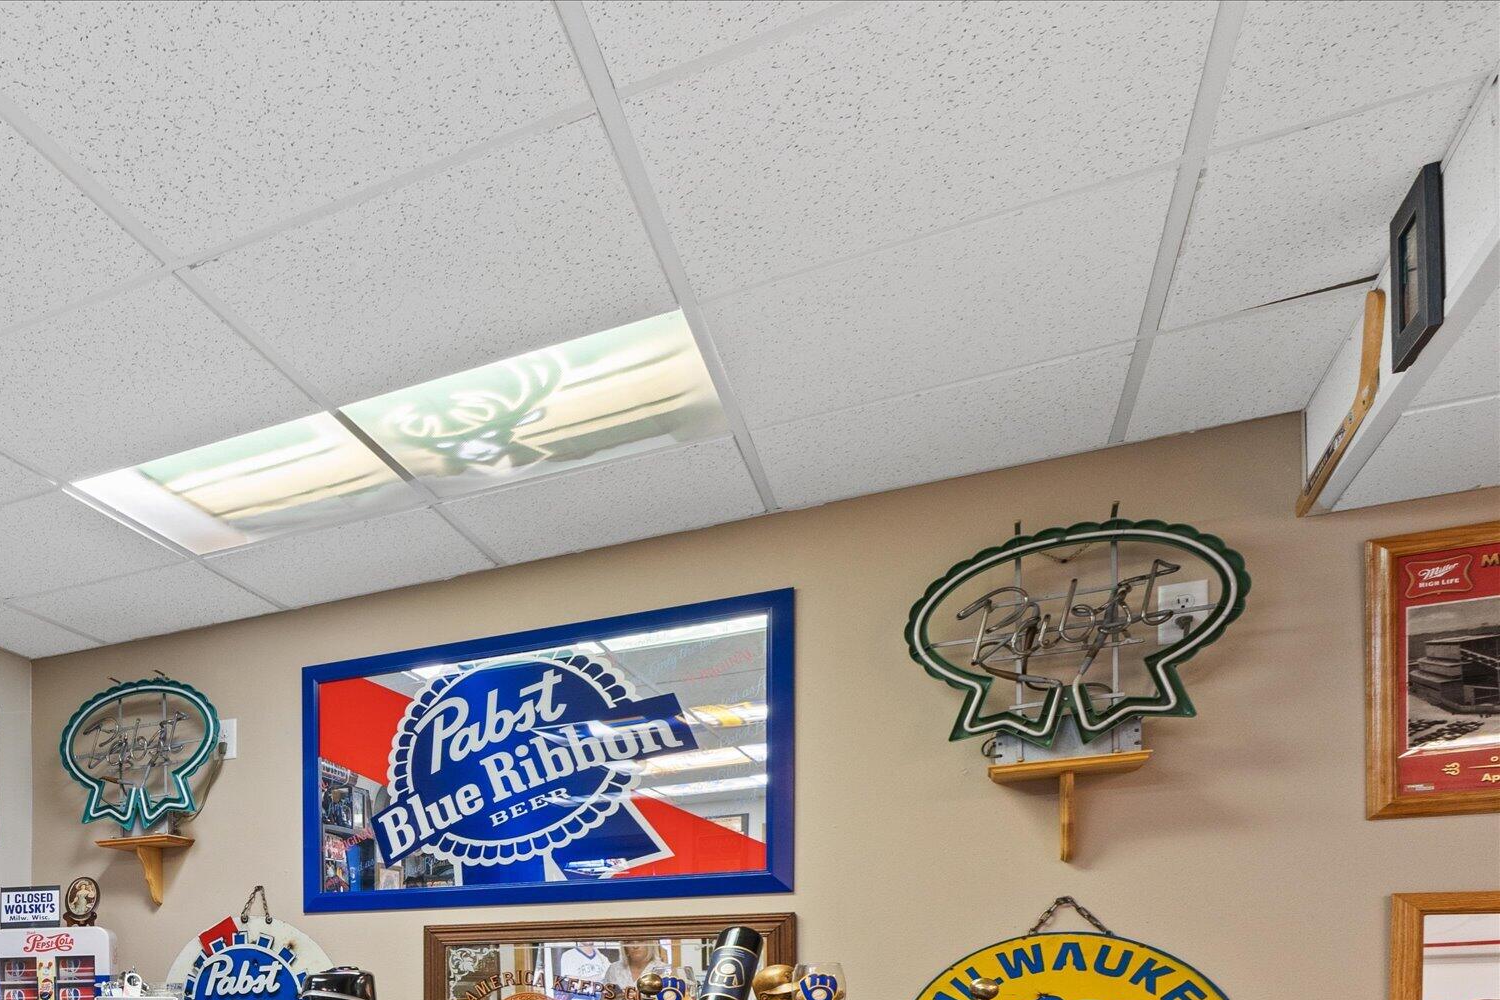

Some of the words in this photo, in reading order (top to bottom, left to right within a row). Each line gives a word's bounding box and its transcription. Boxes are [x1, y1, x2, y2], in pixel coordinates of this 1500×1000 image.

[1418, 563, 1460, 580] Miller
[1418, 580, 1440, 588] HIGH
[1441, 577, 1460, 586] LIFE
[414, 668, 567, 775] Pabst
[378, 781, 485, 860] Blue
[479, 716, 684, 802] Ribbon
[489, 787, 572, 827] BEER
[14, 892, 53, 904] CLOSED
[4, 903, 55, 915] WOLSKI'S
[9, 914, 29, 922] Milw.
[205, 957, 283, 996] Pabst
[552, 974, 616, 1000] KEEPS
